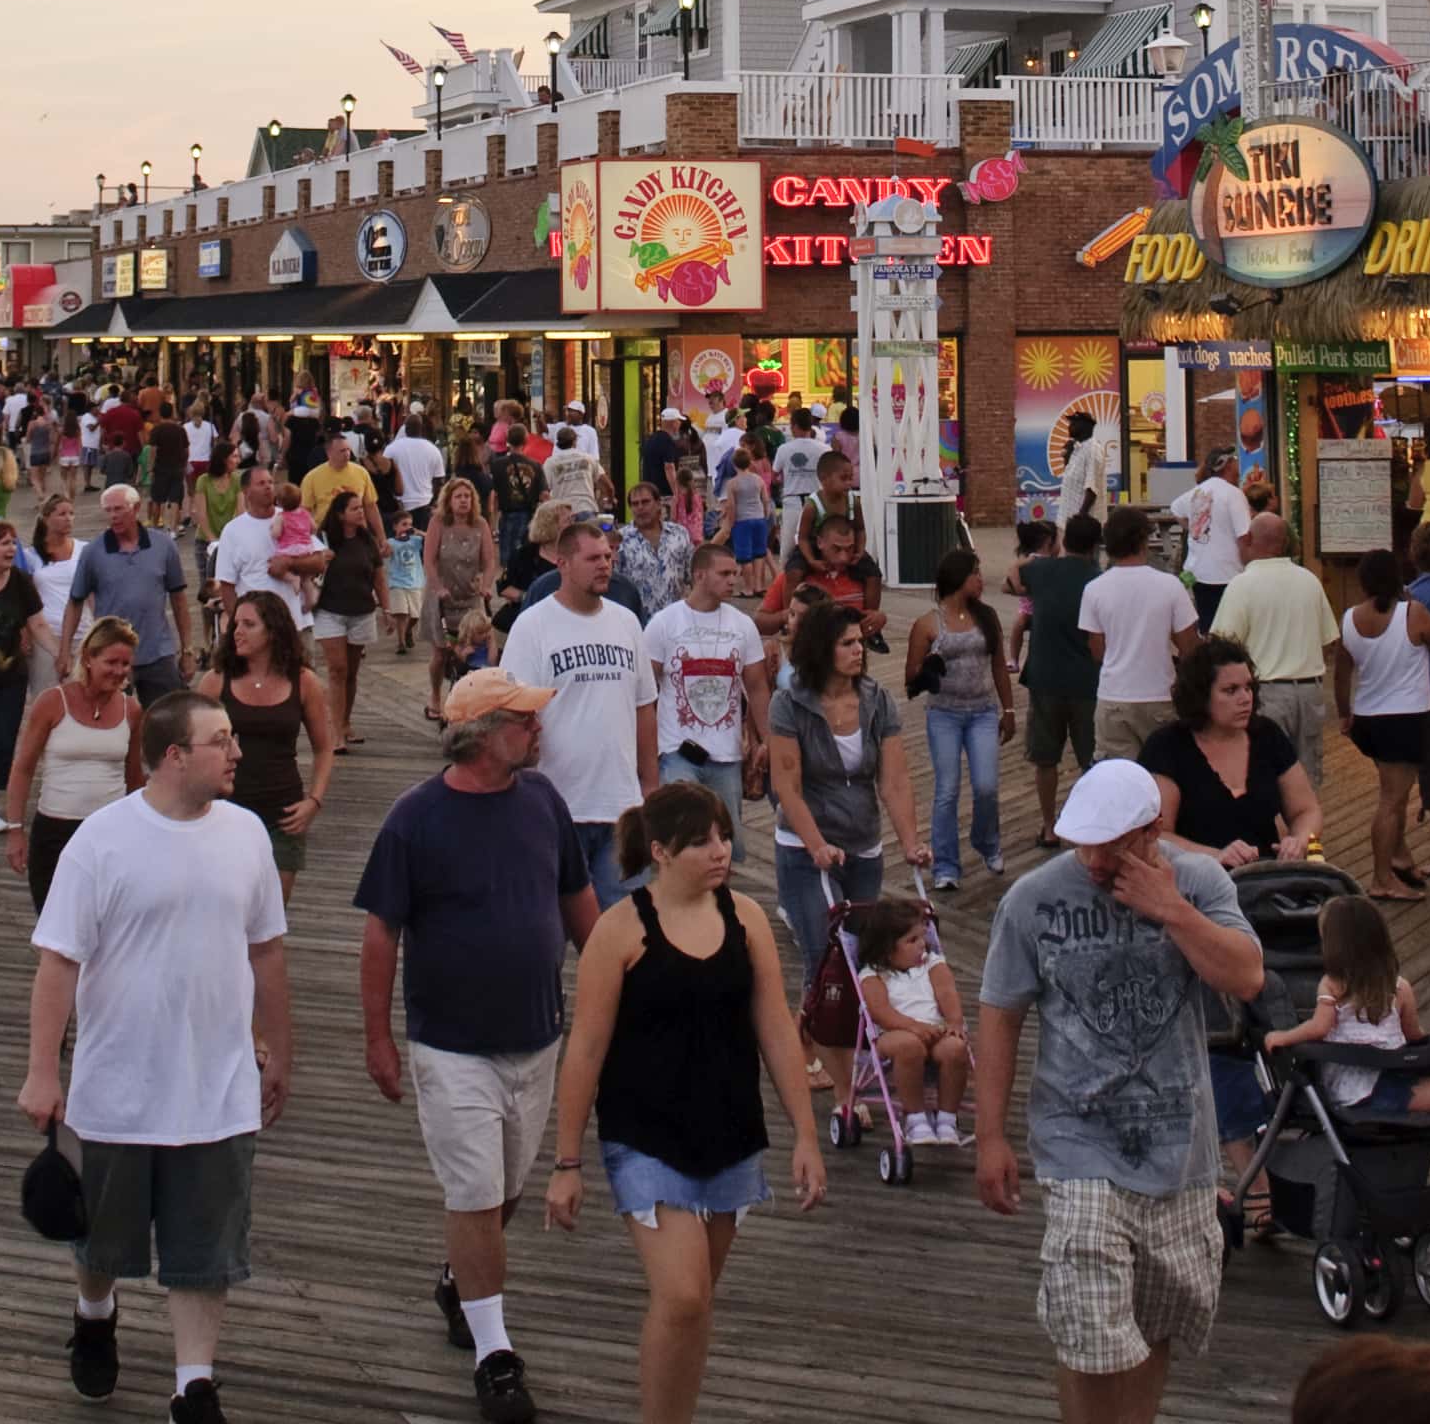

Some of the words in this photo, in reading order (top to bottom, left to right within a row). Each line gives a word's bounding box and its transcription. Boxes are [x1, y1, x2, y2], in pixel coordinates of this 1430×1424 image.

[1247, 138, 1301, 184] TIKI
[613, 170, 666, 240] CANDY
[671, 166, 749, 240] KITCHEN
[772, 176, 953, 207] CANDY
[1223, 183, 1334, 233] SUNRISE
[764, 235, 993, 265] KITEN
[1124, 233, 1207, 283] FOOD
[1195, 345, 1220, 371] dogs
[1228, 346, 1272, 367] nachos
[1275, 343, 1316, 367] Pulled
[1320, 344, 1349, 368] Pork
[550, 643, 636, 677] REHOBOTH
